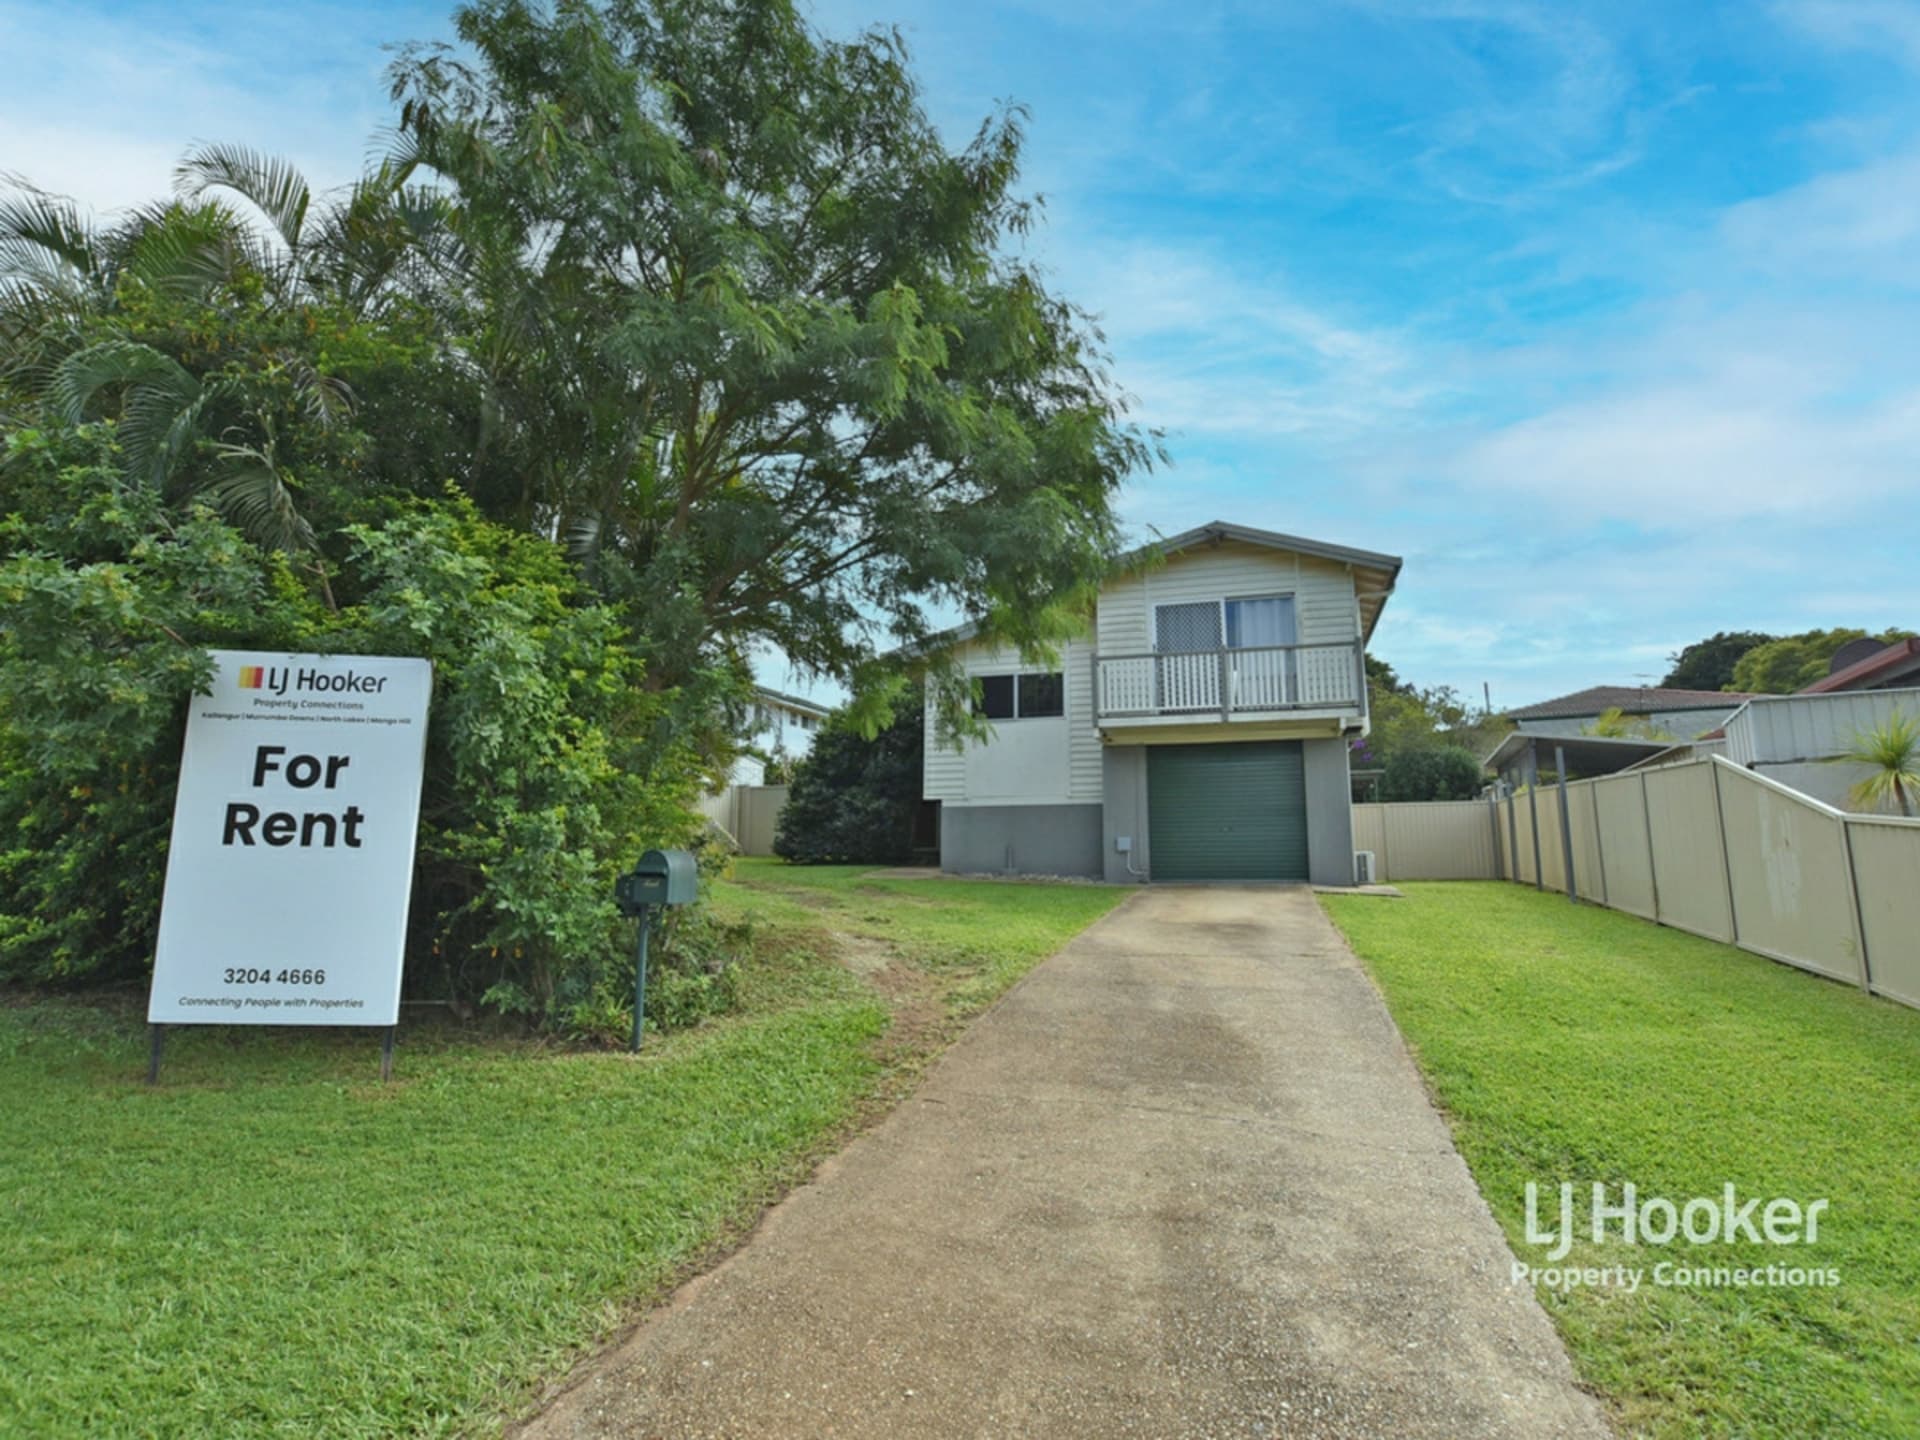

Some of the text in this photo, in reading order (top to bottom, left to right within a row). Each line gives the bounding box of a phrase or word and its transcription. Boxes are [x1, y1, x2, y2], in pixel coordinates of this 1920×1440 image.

[268, 667, 388, 696] LJ Hooker
[253, 698, 364, 710] Property Connections
[252, 745, 350, 789] For
[222, 803, 364, 848] Rent
[223, 968, 326, 985] 3204 4666
[178, 996, 364, 1010] Connecting People with Properties
